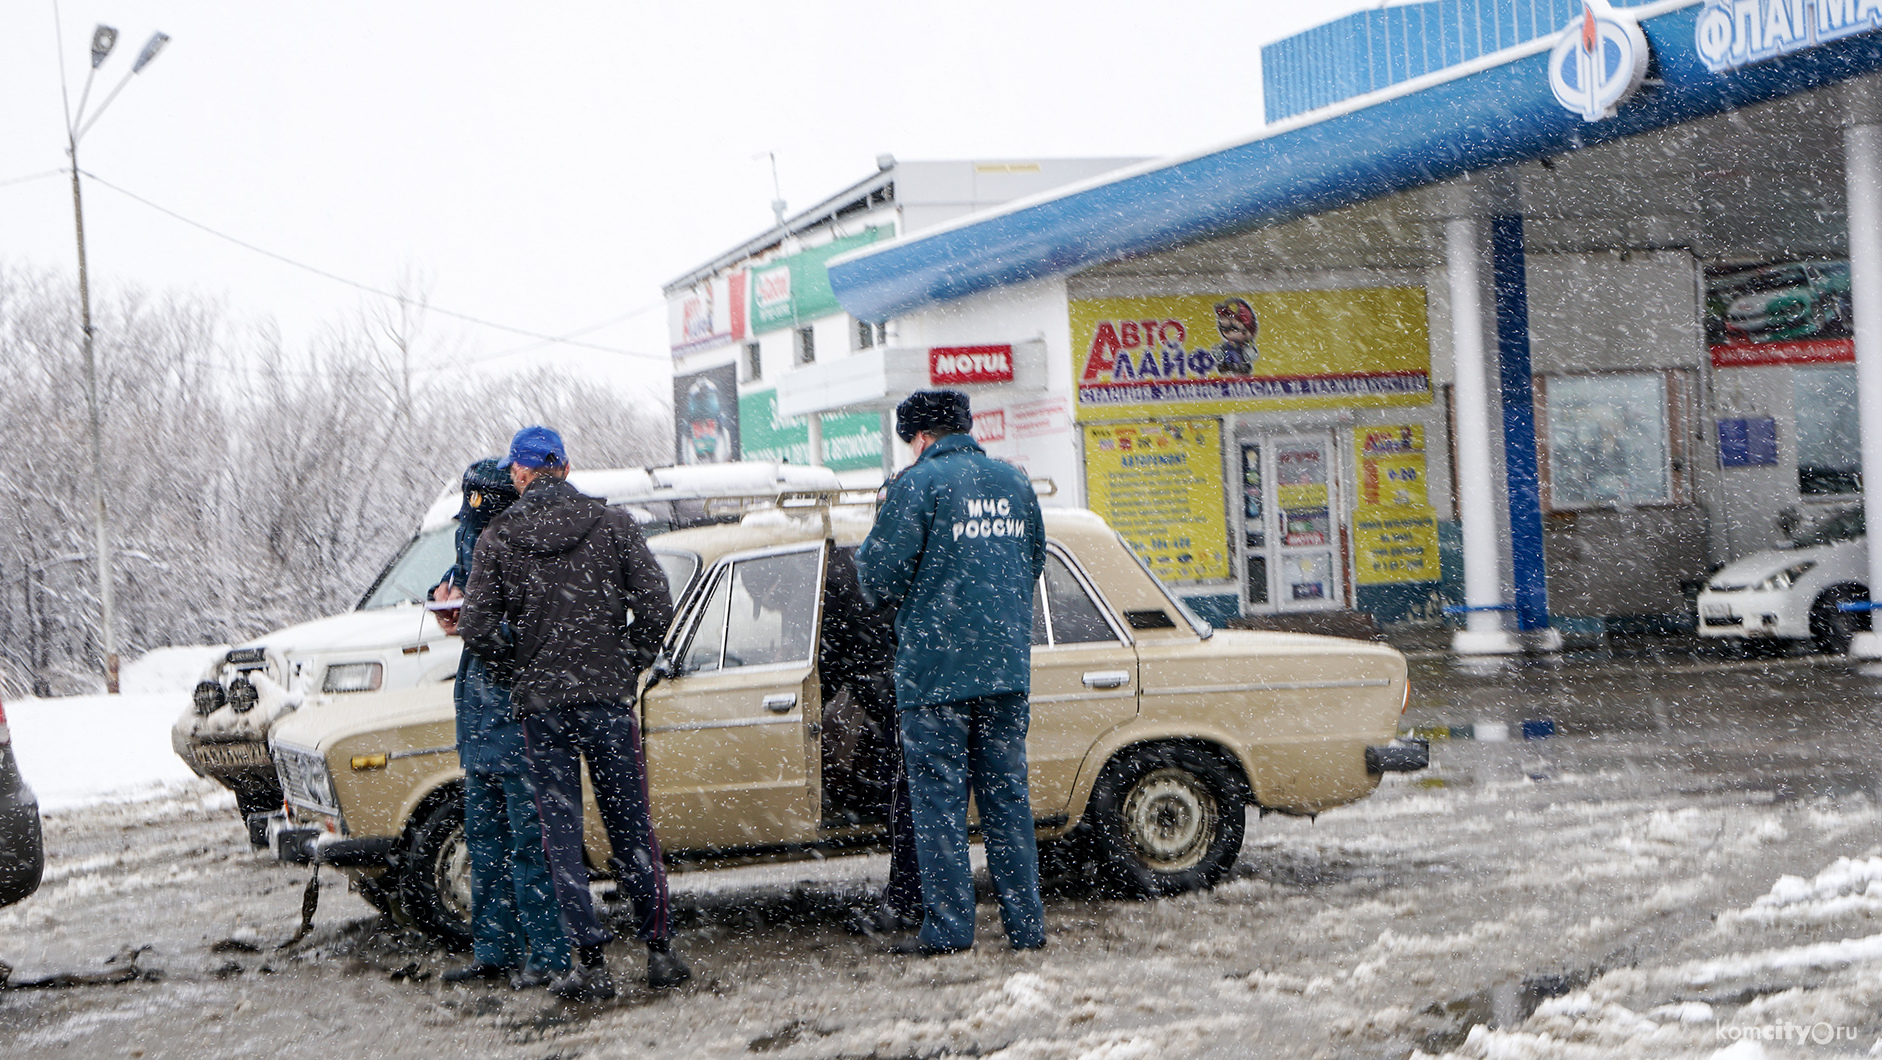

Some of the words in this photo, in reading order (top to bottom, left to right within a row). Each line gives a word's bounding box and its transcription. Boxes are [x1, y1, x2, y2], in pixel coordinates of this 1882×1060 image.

[1083, 320, 1185, 381] АВТО
[1113, 343, 1216, 380] ЛАЙФ
[936, 353, 1010, 375] MOTUL
[967, 498, 1010, 518] МЧС
[952, 518, 1025, 542] РОССИИ
